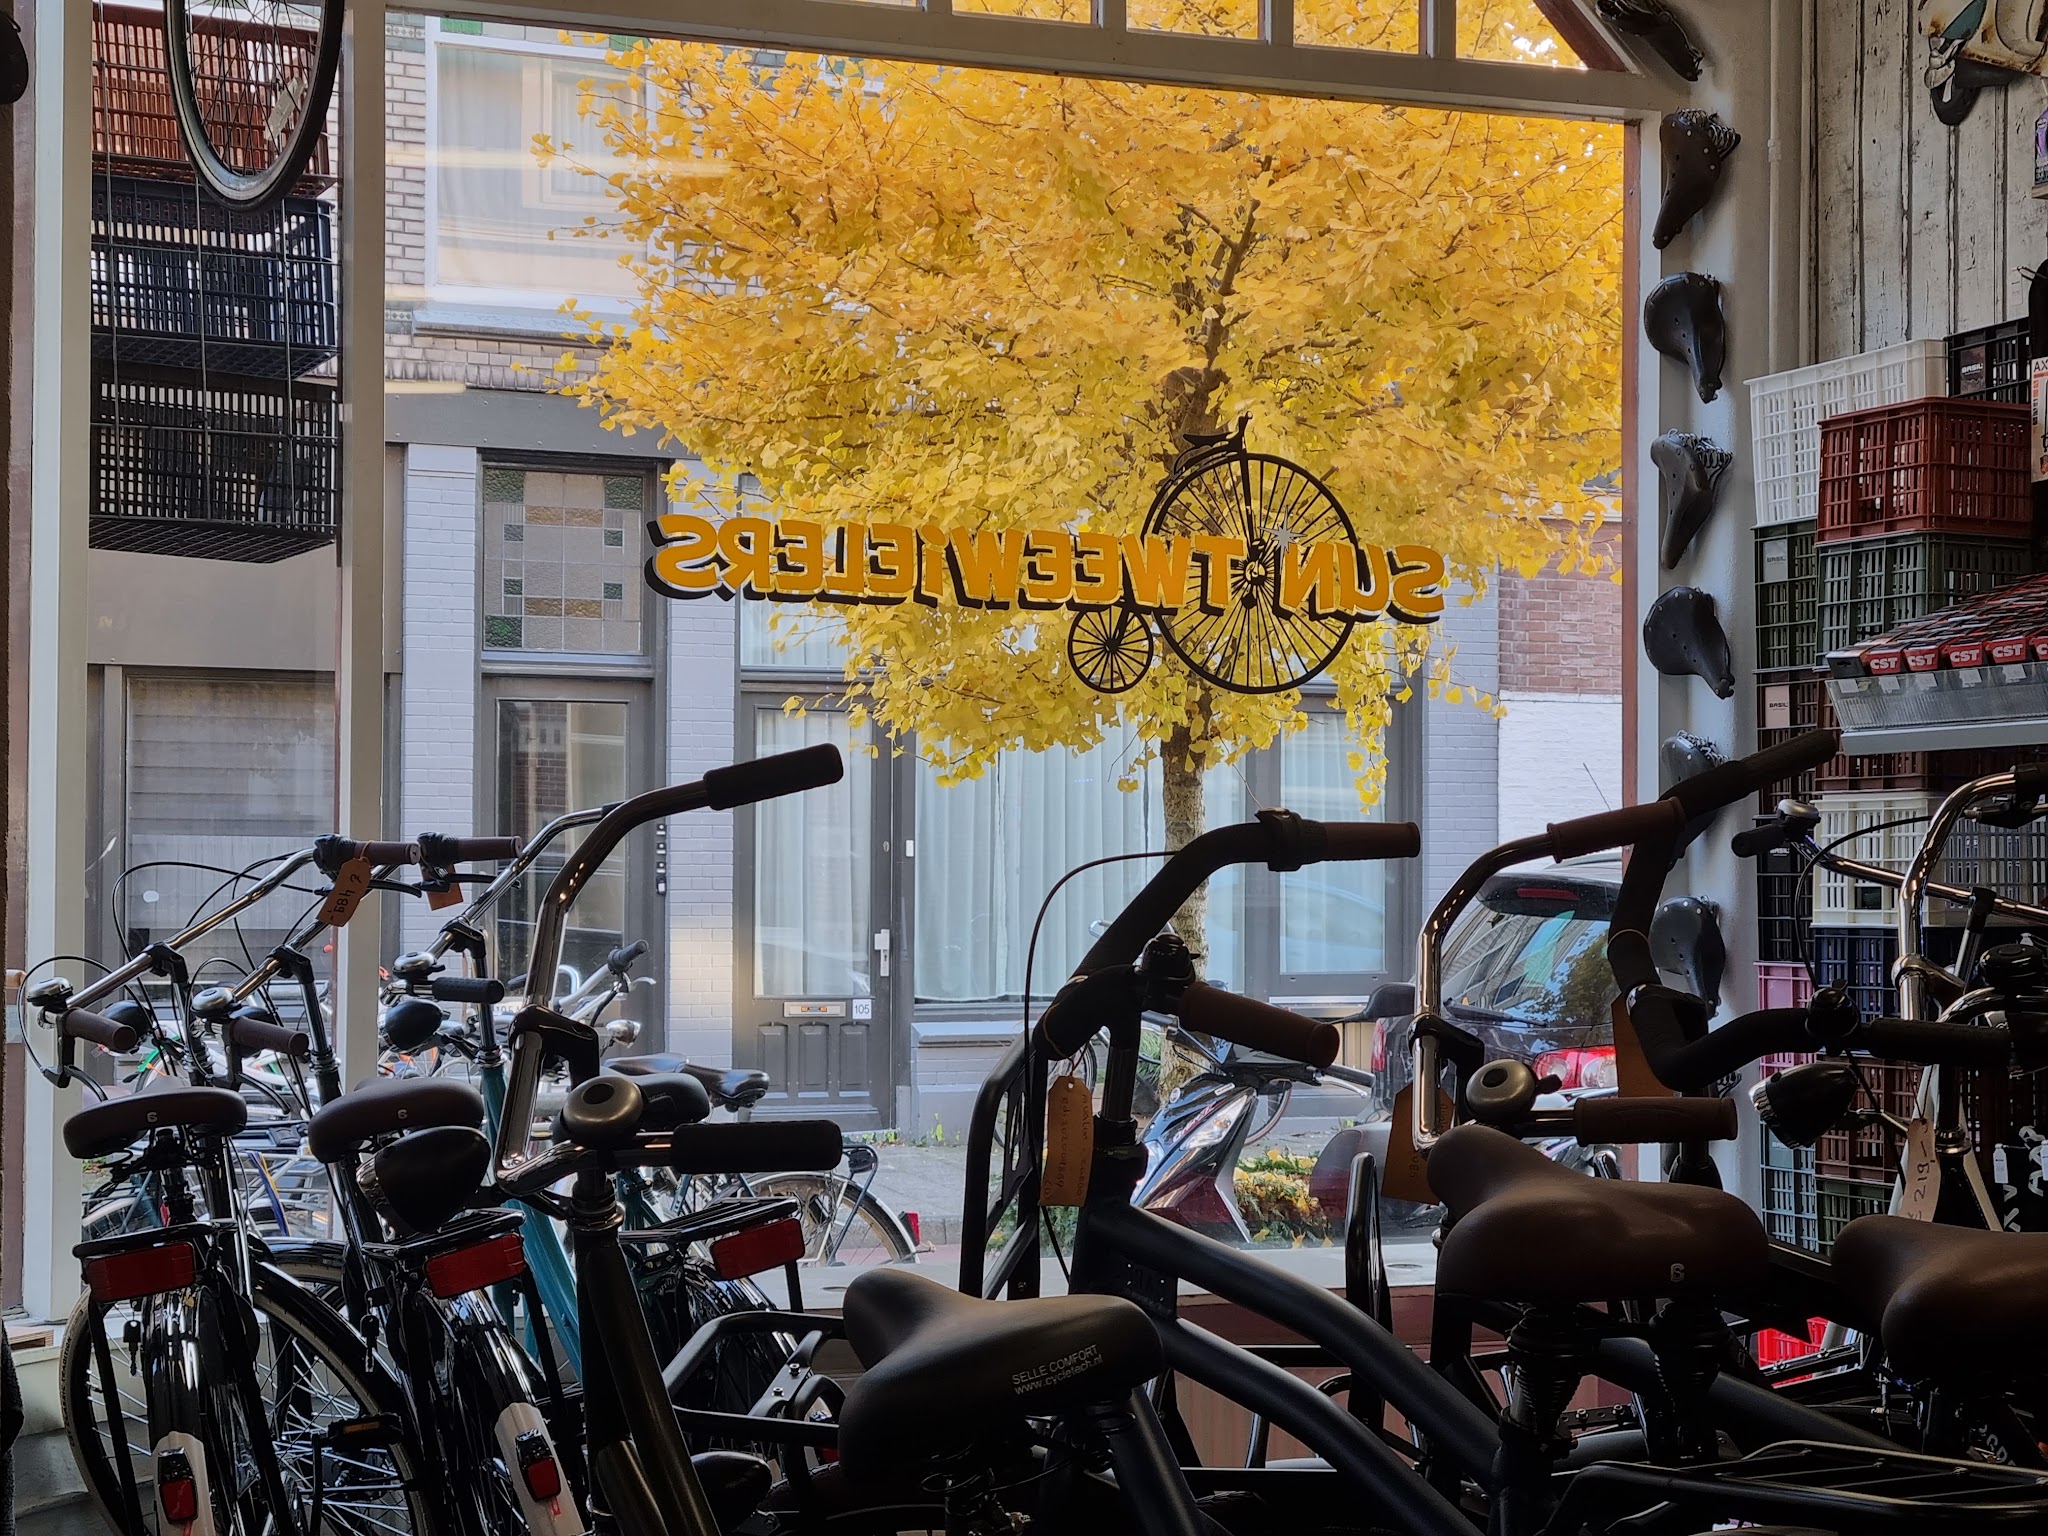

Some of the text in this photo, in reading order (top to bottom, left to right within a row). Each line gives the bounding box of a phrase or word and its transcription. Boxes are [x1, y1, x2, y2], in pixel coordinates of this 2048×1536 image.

[1949, 649, 1979, 663] CST
[1993, 643, 2023, 658] CST
[1870, 657, 1898, 670] CST
[1908, 653, 1935, 667] CST
[855, 1003, 870, 1015] 105
[1011, 1344, 1099, 1385] SELLE COMFORT
